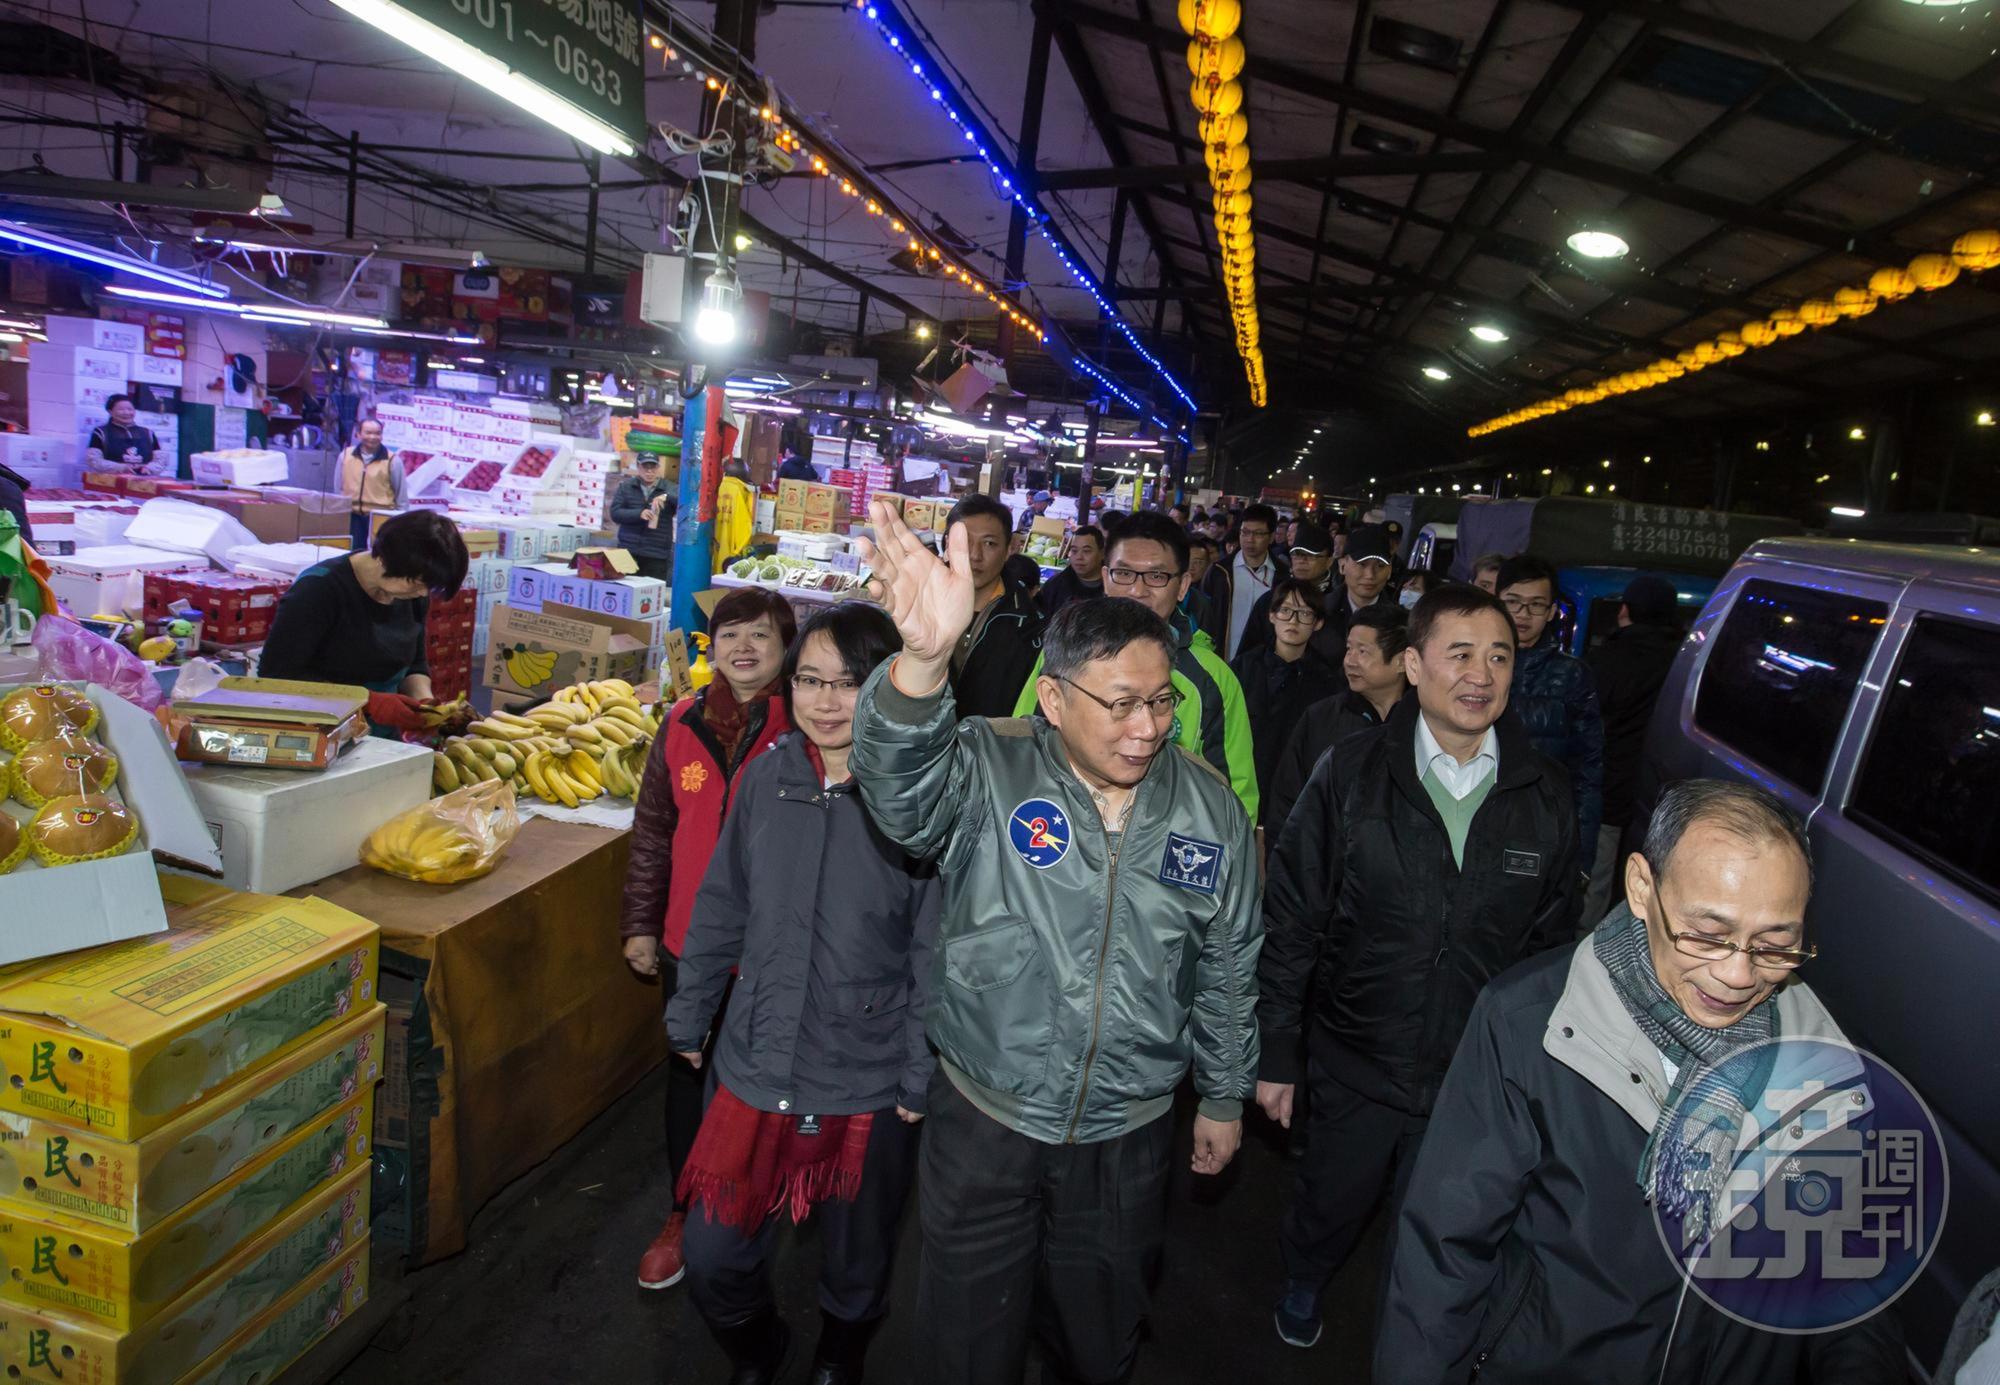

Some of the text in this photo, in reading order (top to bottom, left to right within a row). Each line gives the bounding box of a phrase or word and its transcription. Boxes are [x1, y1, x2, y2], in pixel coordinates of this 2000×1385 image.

[1030, 817, 1049, 848] 2
[29, 1041, 68, 1094] 民
[44, 1136, 82, 1188] 民
[31, 1236, 69, 1286] 民
[28, 1329, 63, 1378] 民
